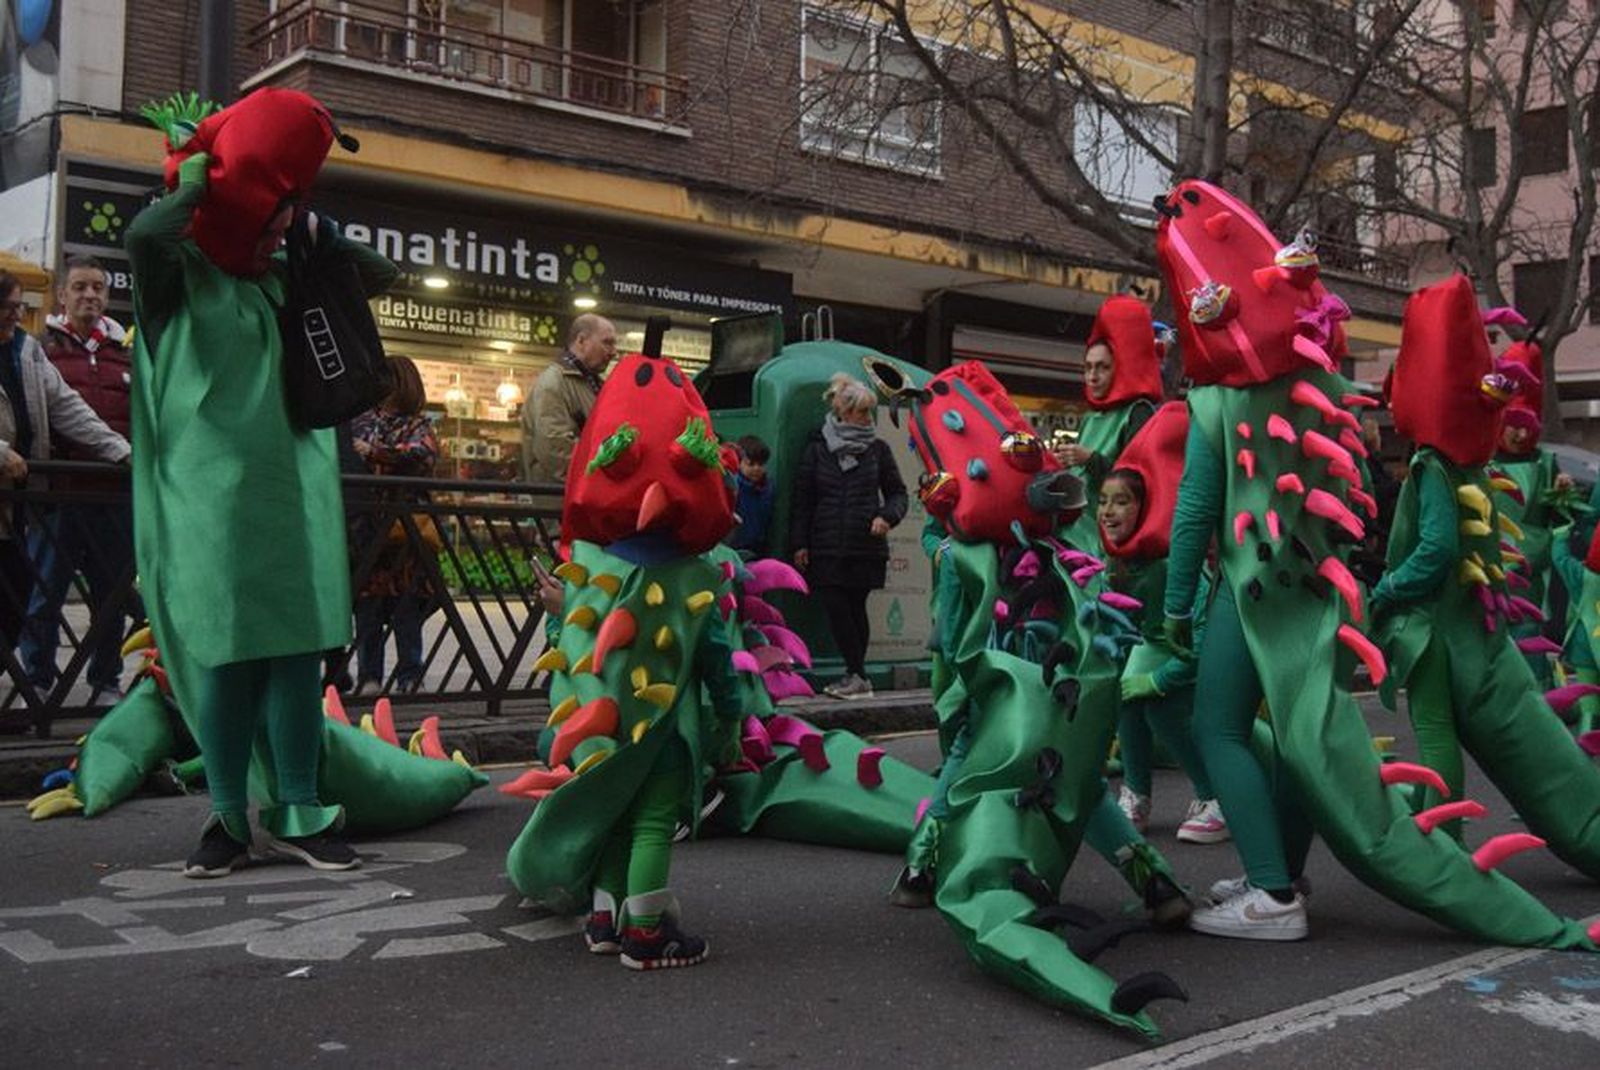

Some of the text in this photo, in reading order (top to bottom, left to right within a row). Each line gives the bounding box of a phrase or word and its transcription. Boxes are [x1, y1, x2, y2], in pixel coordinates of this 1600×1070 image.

[612, 281, 646, 295] TINTA
[647, 286, 656, 297] Y
[693, 293, 720, 306] PARA
[378, 295, 531, 332] debuenatinta
[379, 316, 408, 329] TINTA
[409, 320, 416, 329] Y
[449, 325, 474, 336] PARA
